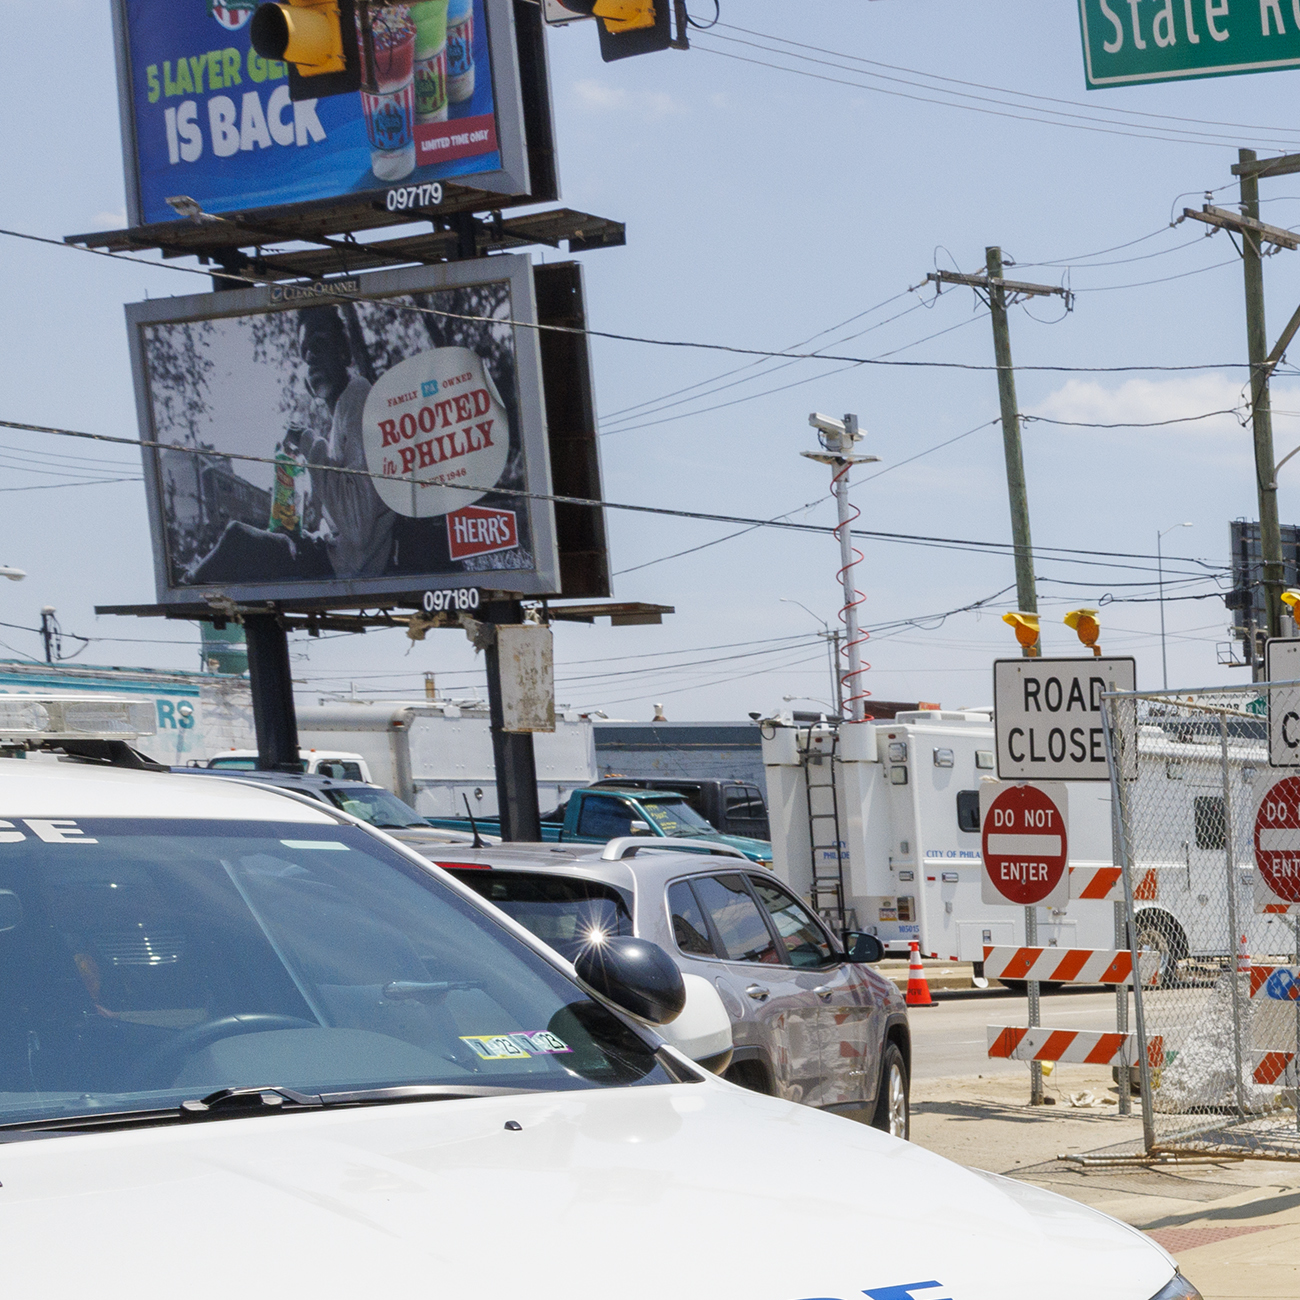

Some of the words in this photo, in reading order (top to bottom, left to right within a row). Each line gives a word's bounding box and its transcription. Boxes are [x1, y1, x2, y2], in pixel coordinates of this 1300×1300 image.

[1100, 0, 1230, 53] State
[146, 64, 160, 104] 5
[163, 47, 243, 97] LAYER
[164, 100, 204, 165] IS
[208, 84, 327, 157] BACK
[421, 135, 450, 152] LIMITED
[450, 132, 470, 147] TIME
[470, 129, 489, 143] ONLY
[387, 182, 443, 211] 097179
[387, 390, 418, 407] FAMILY
[442, 372, 473, 389] OWNED
[377, 388, 491, 448] ROOTED
[382, 456, 397, 475] in
[398, 419, 495, 475] PHILLY
[453, 514, 511, 545] HERR'S
[423, 588, 480, 611] 097180
[1024, 677, 1106, 712] ROAD
[1008, 727, 1115, 763] CLOSE
[994, 809, 1015, 827] DO
[1024, 810, 1054, 828] NOT
[1266, 802, 1288, 821] DO
[926, 850, 944, 859] CITY
[946, 850, 957, 858] OF
[959, 851, 981, 859] PHILA
[1001, 862, 1048, 881] ENTER
[495, 1039, 521, 1055] 23
[539, 1033, 565, 1050] 23
